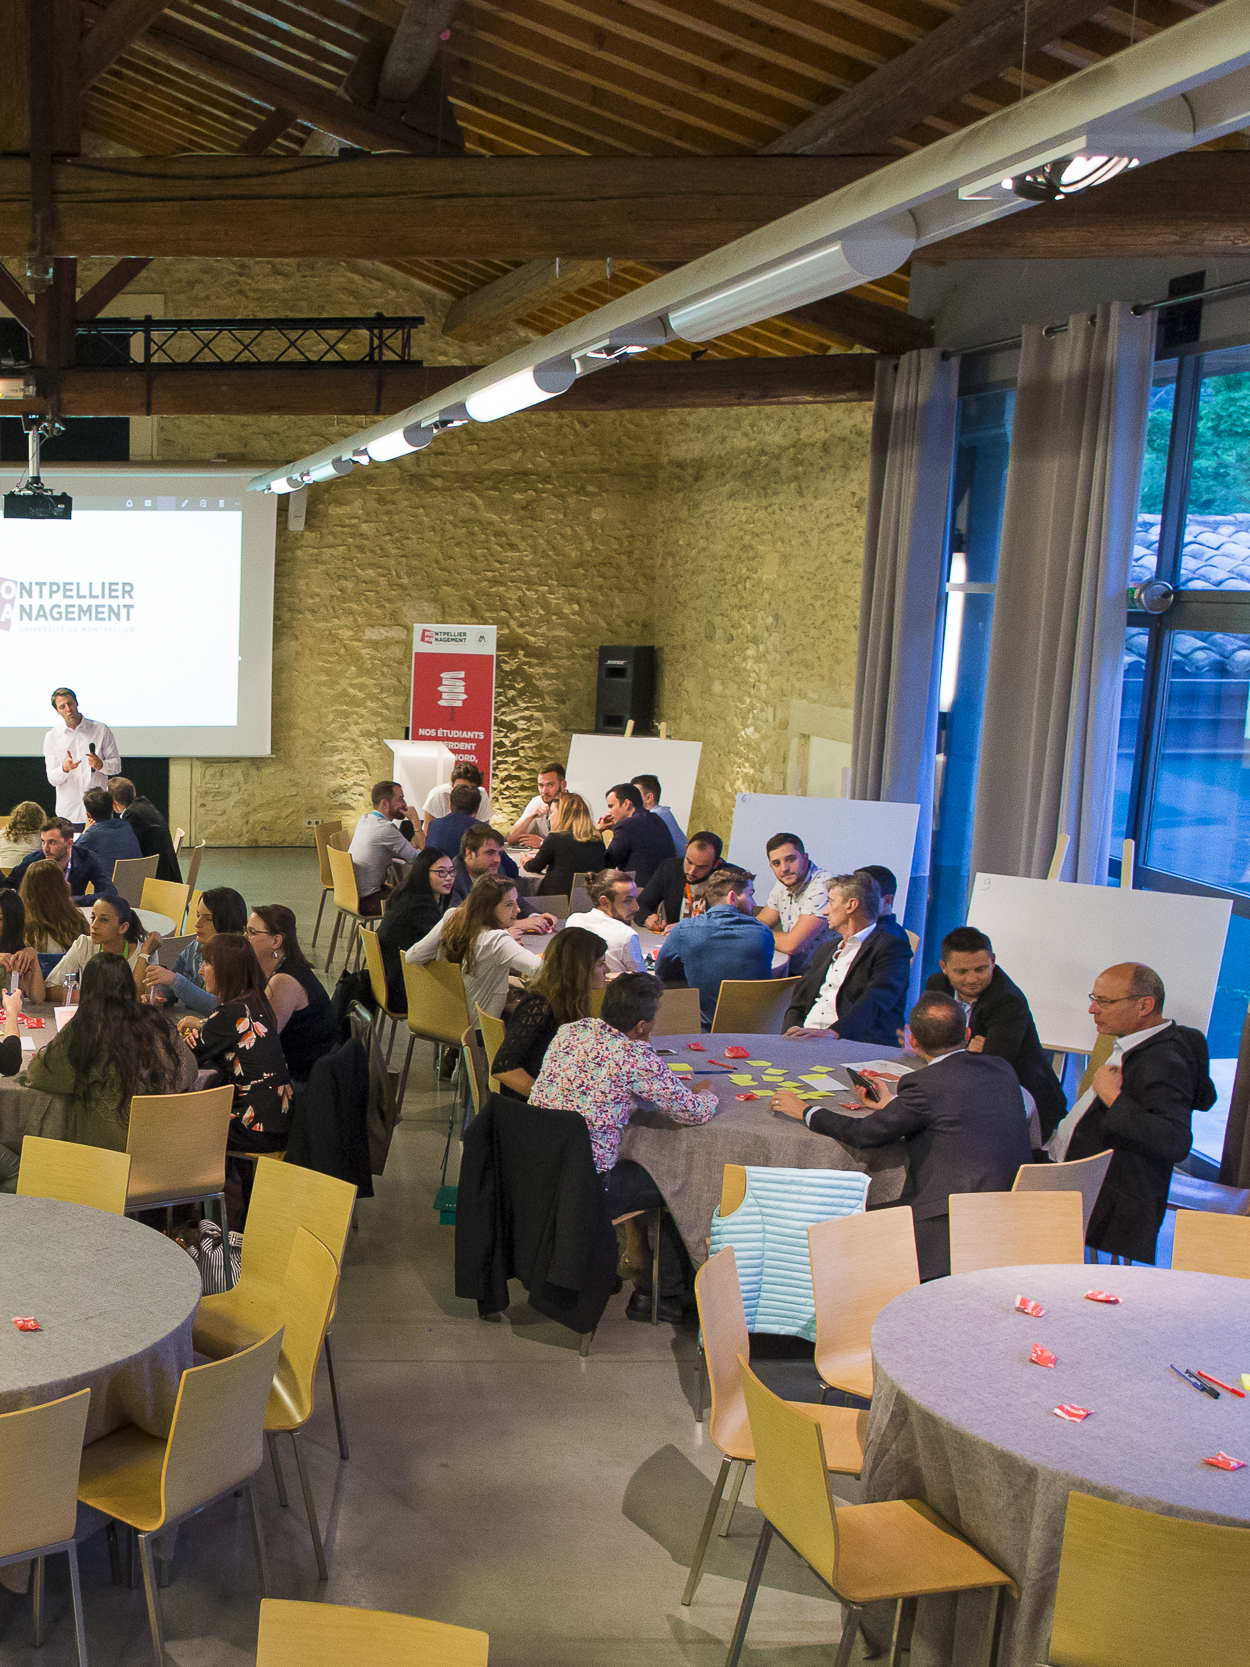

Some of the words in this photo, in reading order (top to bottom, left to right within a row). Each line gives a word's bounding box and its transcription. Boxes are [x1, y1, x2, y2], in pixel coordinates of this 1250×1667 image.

[418, 728, 436, 736] NOS
[437, 728, 484, 739] ÉTUDIANTS
[741, 794, 747, 803] 6
[980, 878, 992, 891] 9
